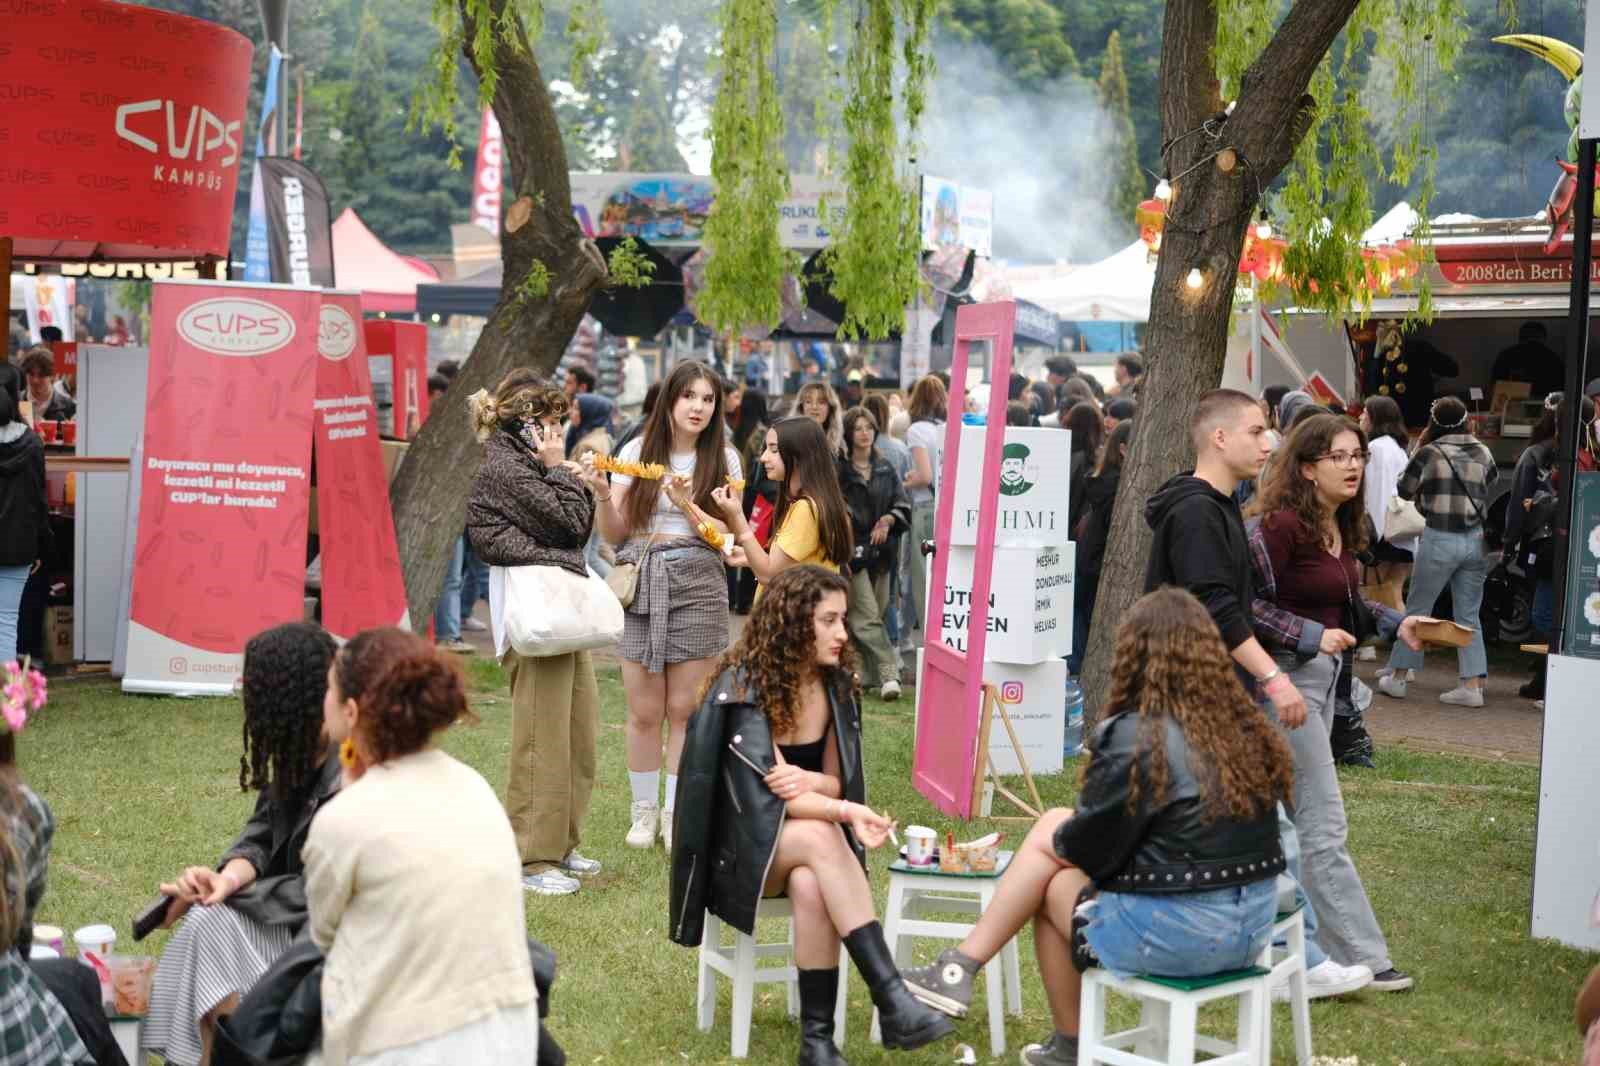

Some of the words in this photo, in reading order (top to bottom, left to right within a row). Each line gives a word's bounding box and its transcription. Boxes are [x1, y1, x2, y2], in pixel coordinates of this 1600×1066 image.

[115, 98, 241, 168] CUPS
[153, 165, 223, 191] KAMPÜS
[1456, 263, 1525, 281] 2008'den
[1531, 262, 1563, 280] Beri
[192, 312, 281, 337] CUPS
[147, 457, 211, 476] Doyurucu
[213, 461, 235, 474] mu
[237, 461, 306, 480] doyurucu,
[216, 476, 233, 490] mi
[235, 477, 286, 492] lezzetli
[223, 494, 277, 508] burada!
